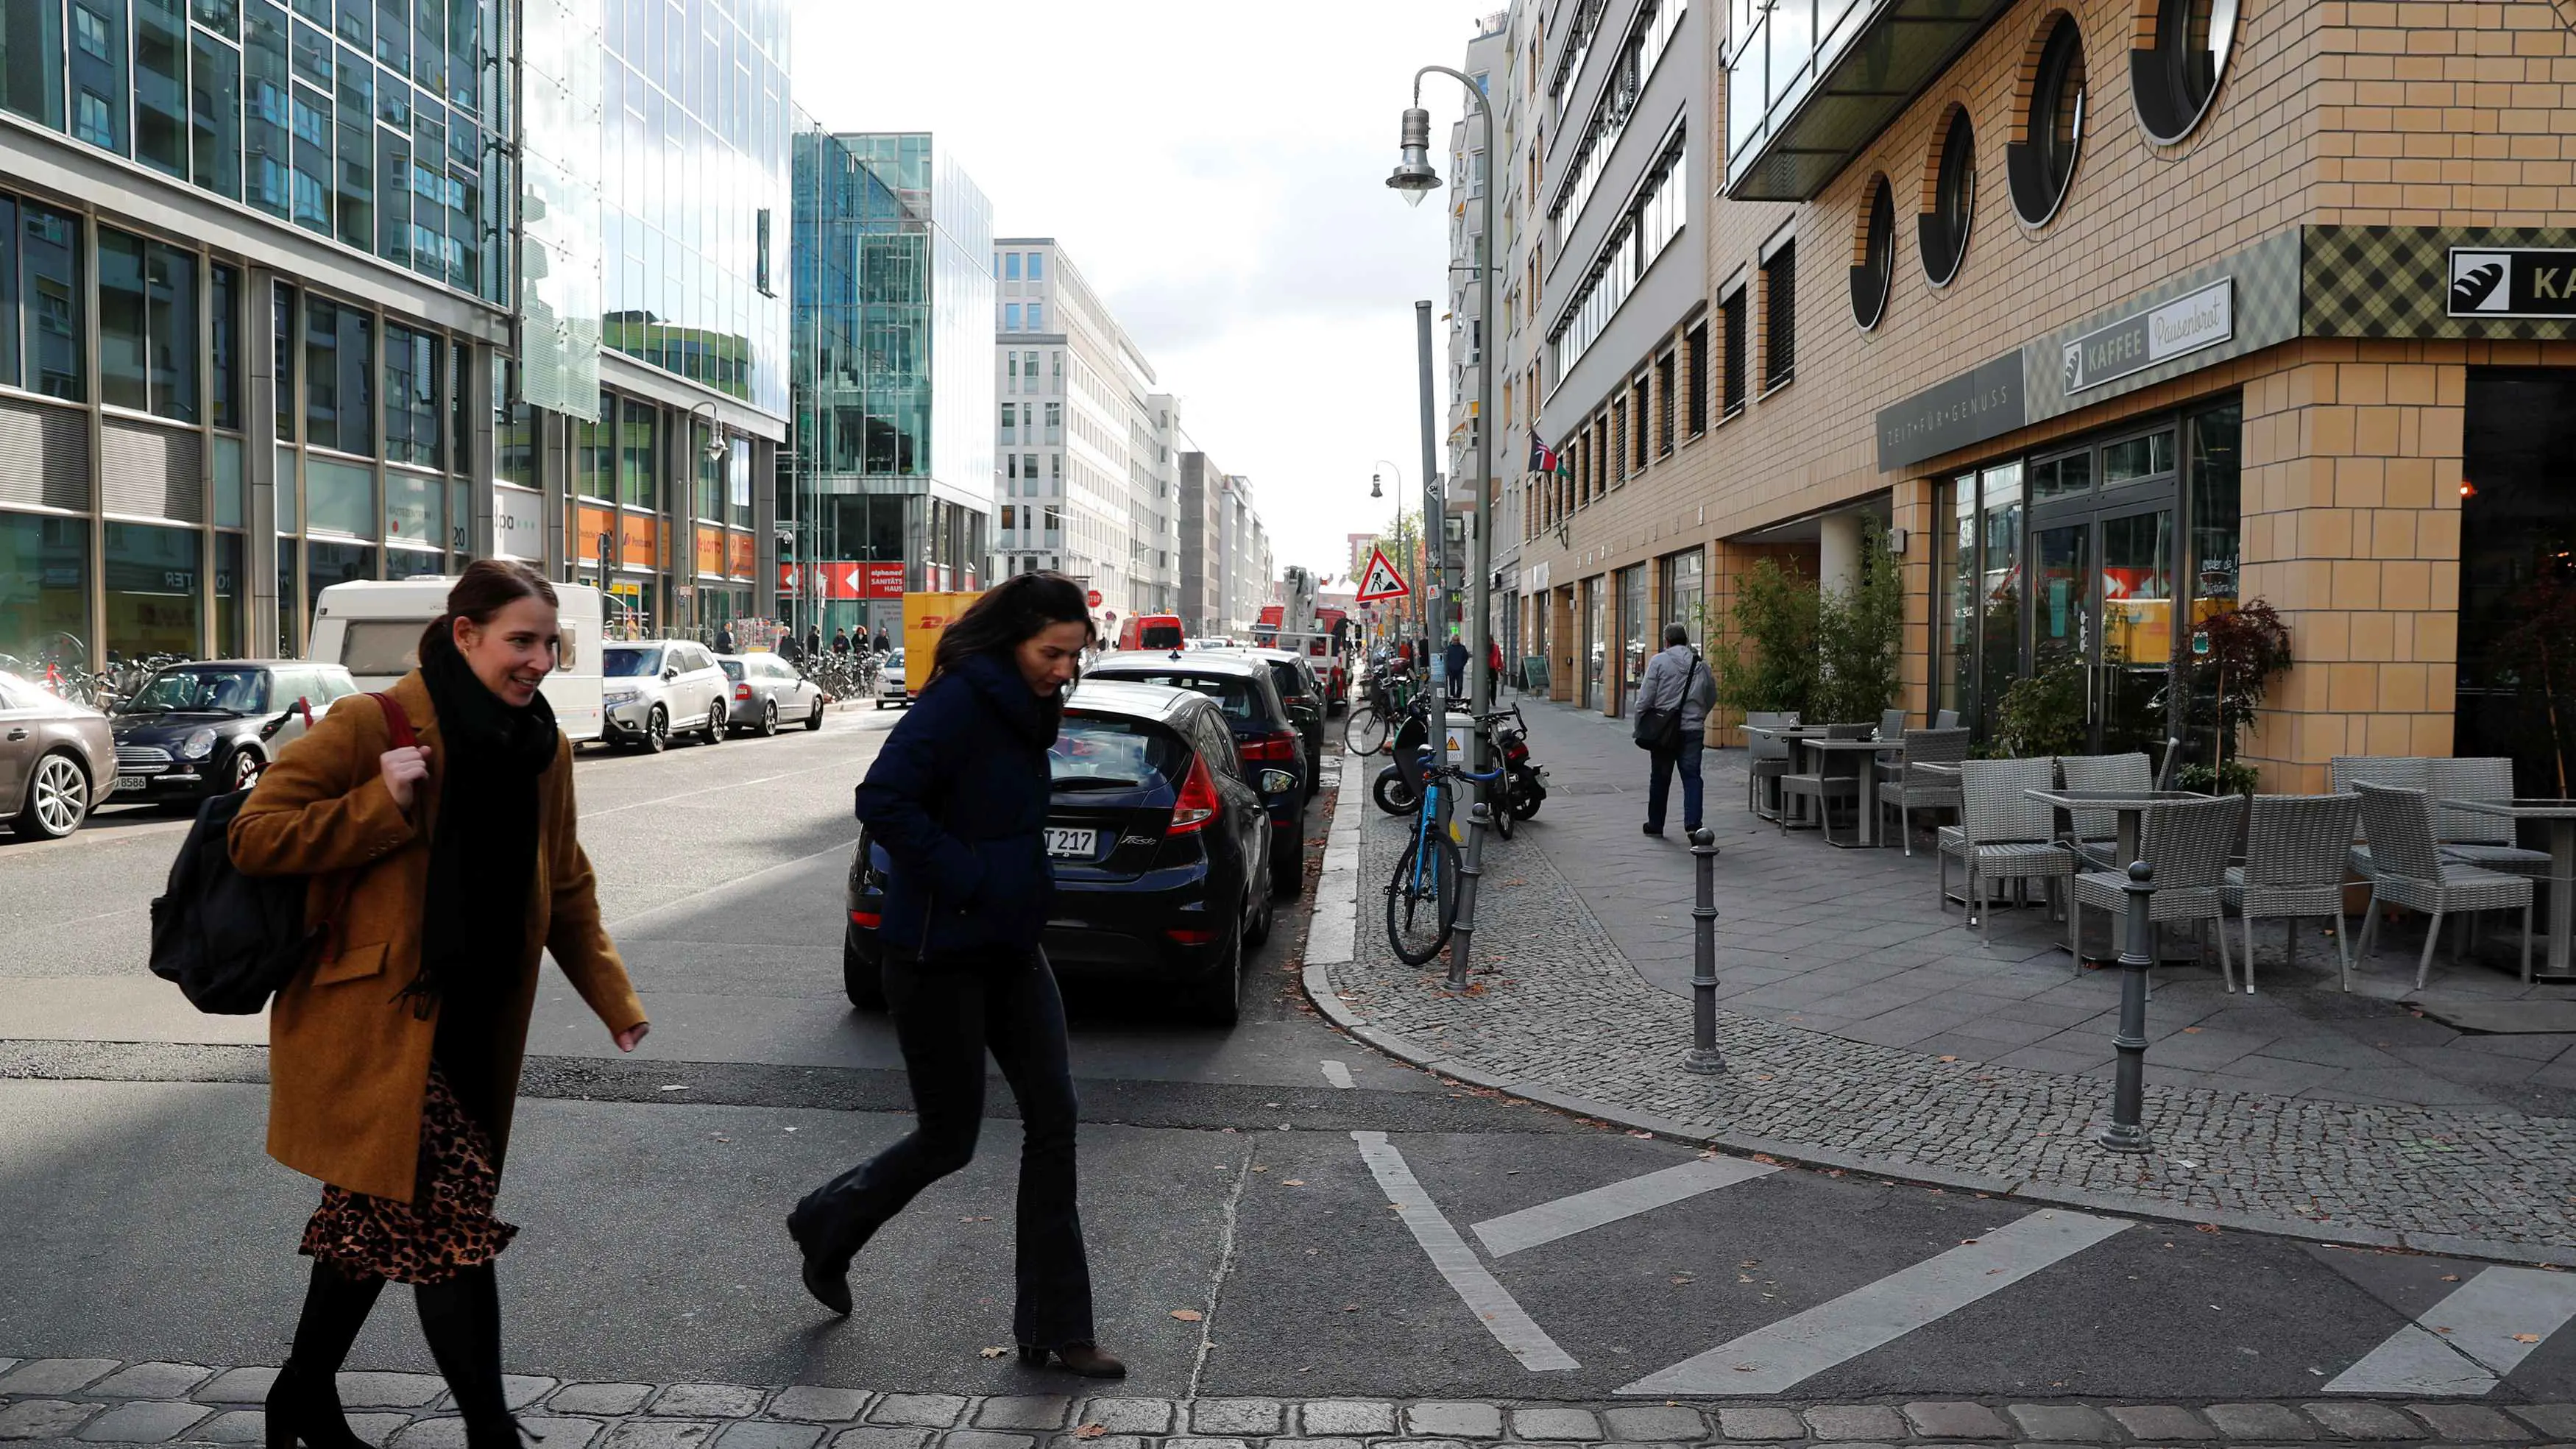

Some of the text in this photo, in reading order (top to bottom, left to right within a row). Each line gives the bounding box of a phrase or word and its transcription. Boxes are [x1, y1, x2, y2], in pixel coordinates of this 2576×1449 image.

[2154, 296, 2221, 347] Pausenbrot
[2087, 328, 2142, 373] KAFFEE
[1952, 385, 2008, 422] GENUSS
[871, 569, 903, 578] alphamed
[871, 577, 903, 585] SANITÄTS
[121, 777, 146, 788] 8586
[1058, 830, 1092, 851] 217
[1121, 835, 1157, 846] Fiesta
